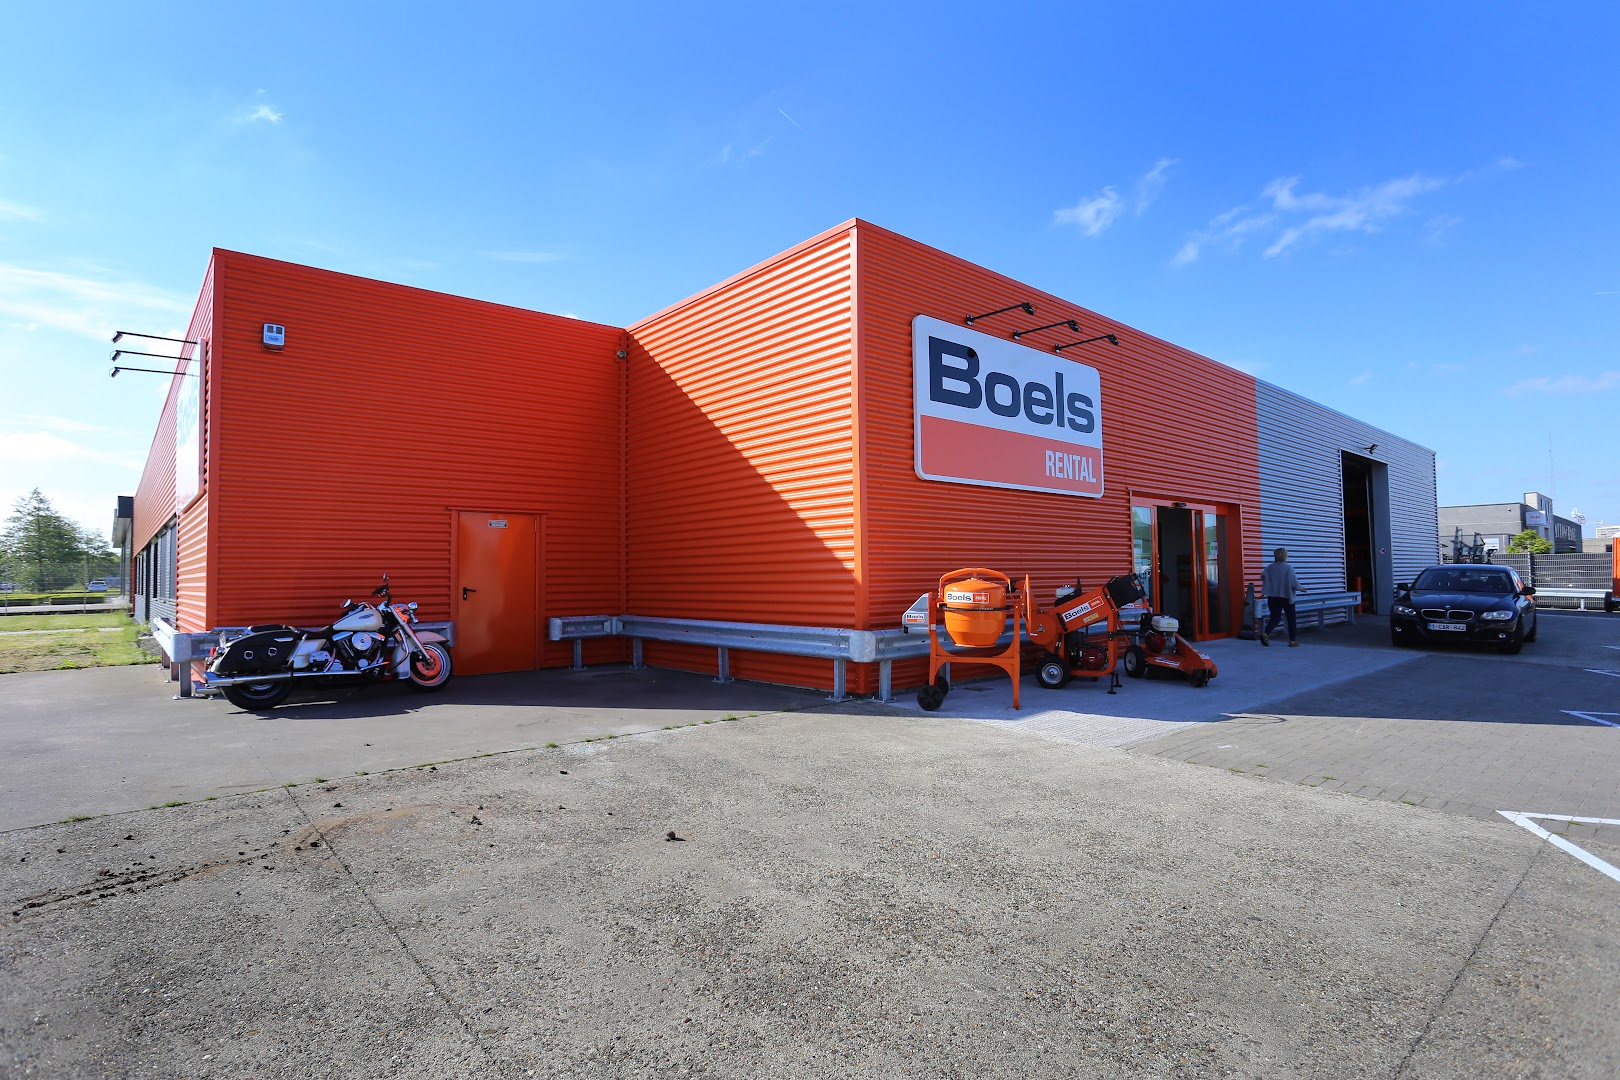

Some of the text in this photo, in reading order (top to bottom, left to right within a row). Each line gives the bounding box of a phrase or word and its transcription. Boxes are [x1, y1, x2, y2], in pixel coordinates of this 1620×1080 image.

[928, 335, 1095, 434] Boels
[1045, 450, 1097, 483] RENTAL
[1064, 605, 1090, 620] Boels
